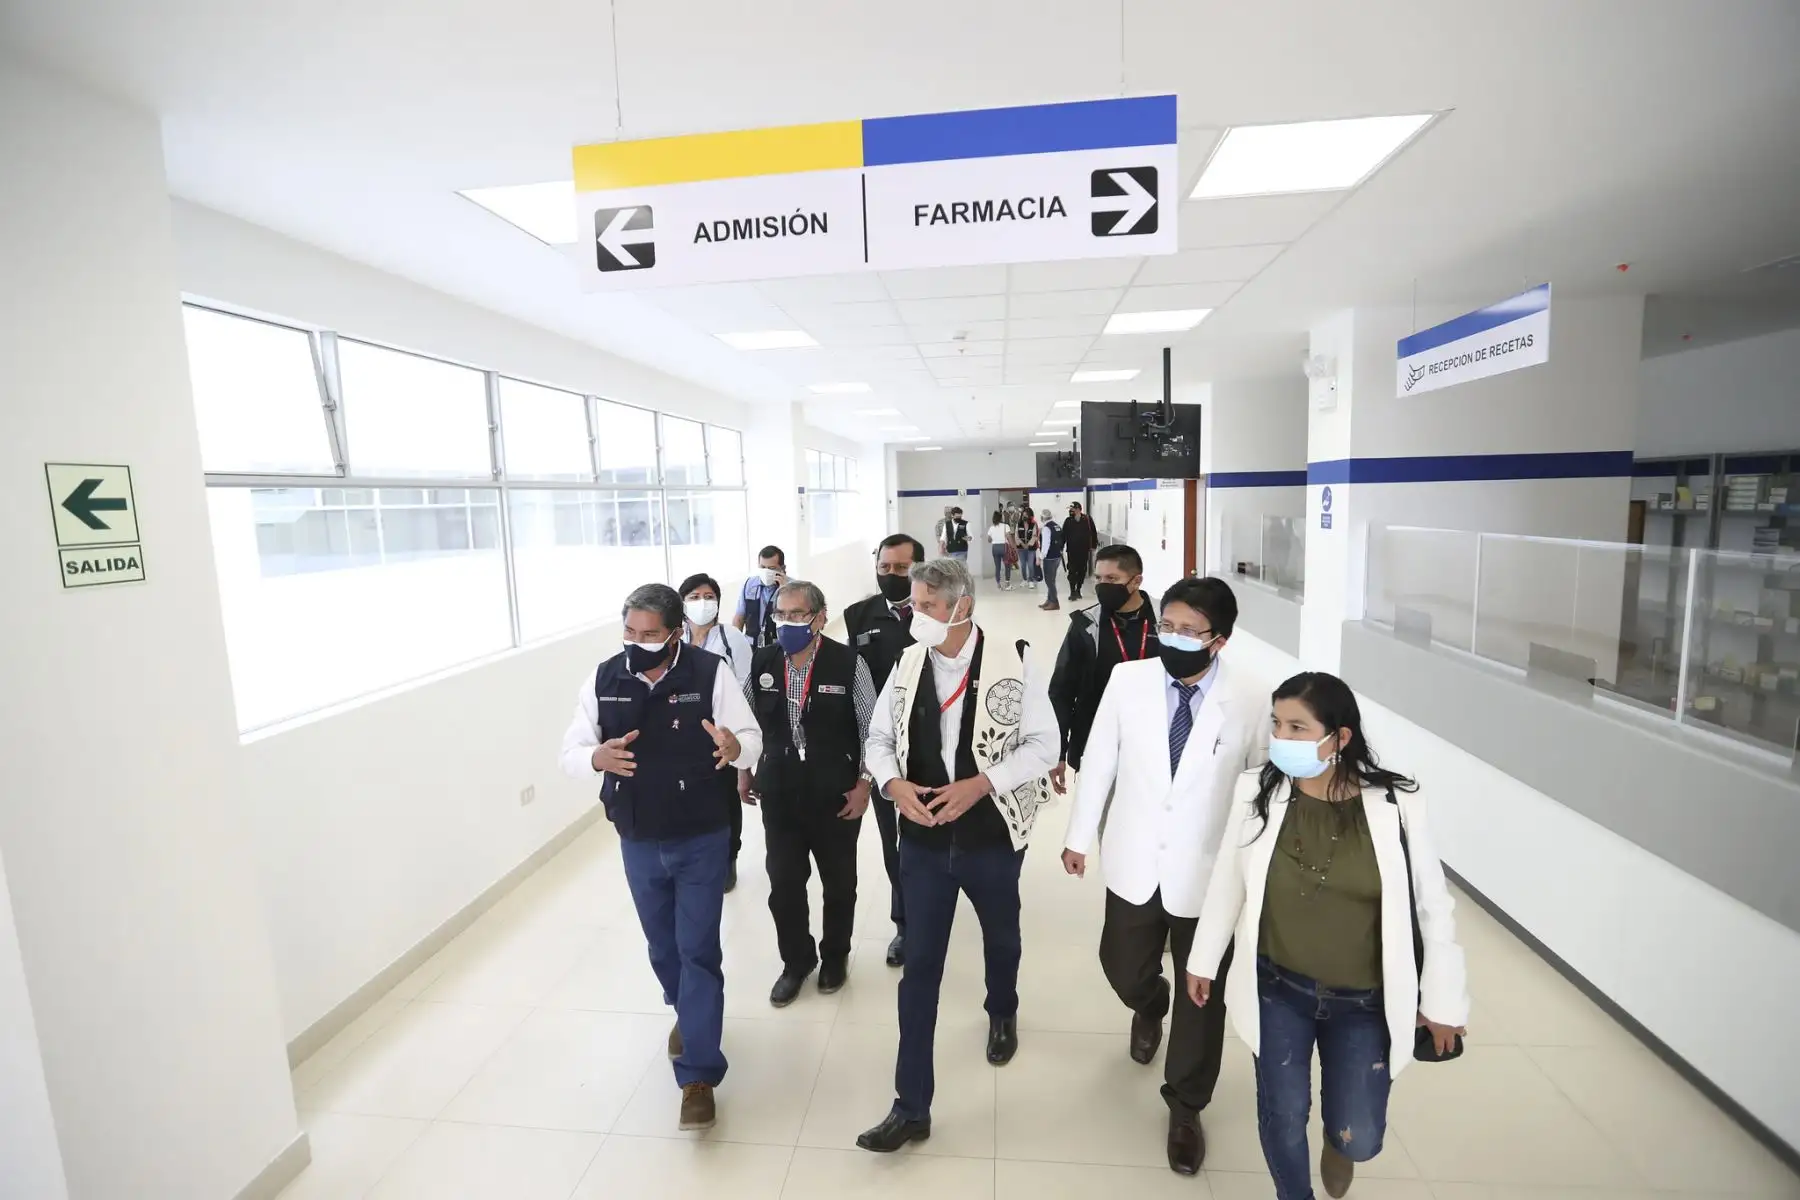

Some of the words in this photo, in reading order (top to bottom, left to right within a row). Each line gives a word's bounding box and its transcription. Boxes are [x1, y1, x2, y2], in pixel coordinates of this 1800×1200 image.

[693, 207, 828, 244] ADMISIÓN
[914, 196, 1067, 227] FARMACIA
[1475, 349, 1487, 362] DE
[1489, 334, 1534, 358] RECETAS
[66, 557, 140, 575] SALIDA
